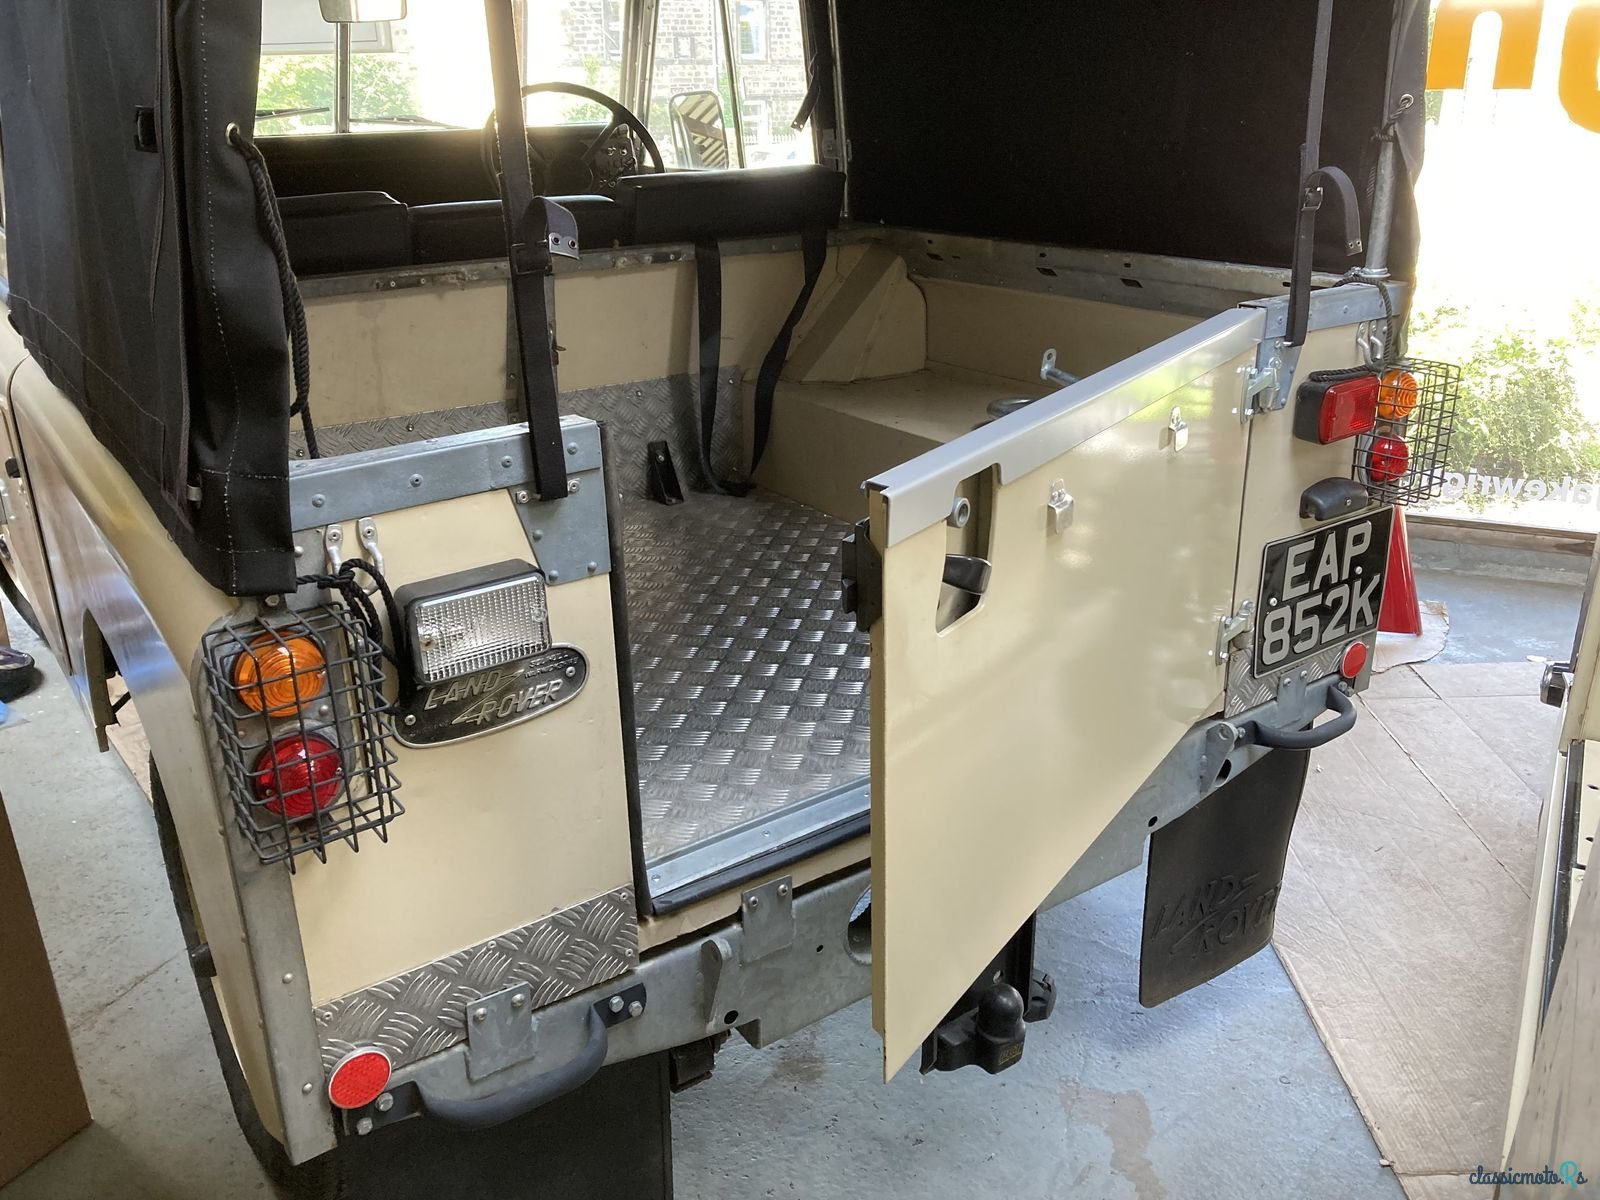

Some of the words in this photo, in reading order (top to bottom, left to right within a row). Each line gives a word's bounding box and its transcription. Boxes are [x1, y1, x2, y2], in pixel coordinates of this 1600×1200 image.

[1282, 520, 1373, 601] EAP
[1262, 573, 1381, 666] 852K
[424, 670, 501, 711] LAND
[474, 678, 564, 726] ROVER
